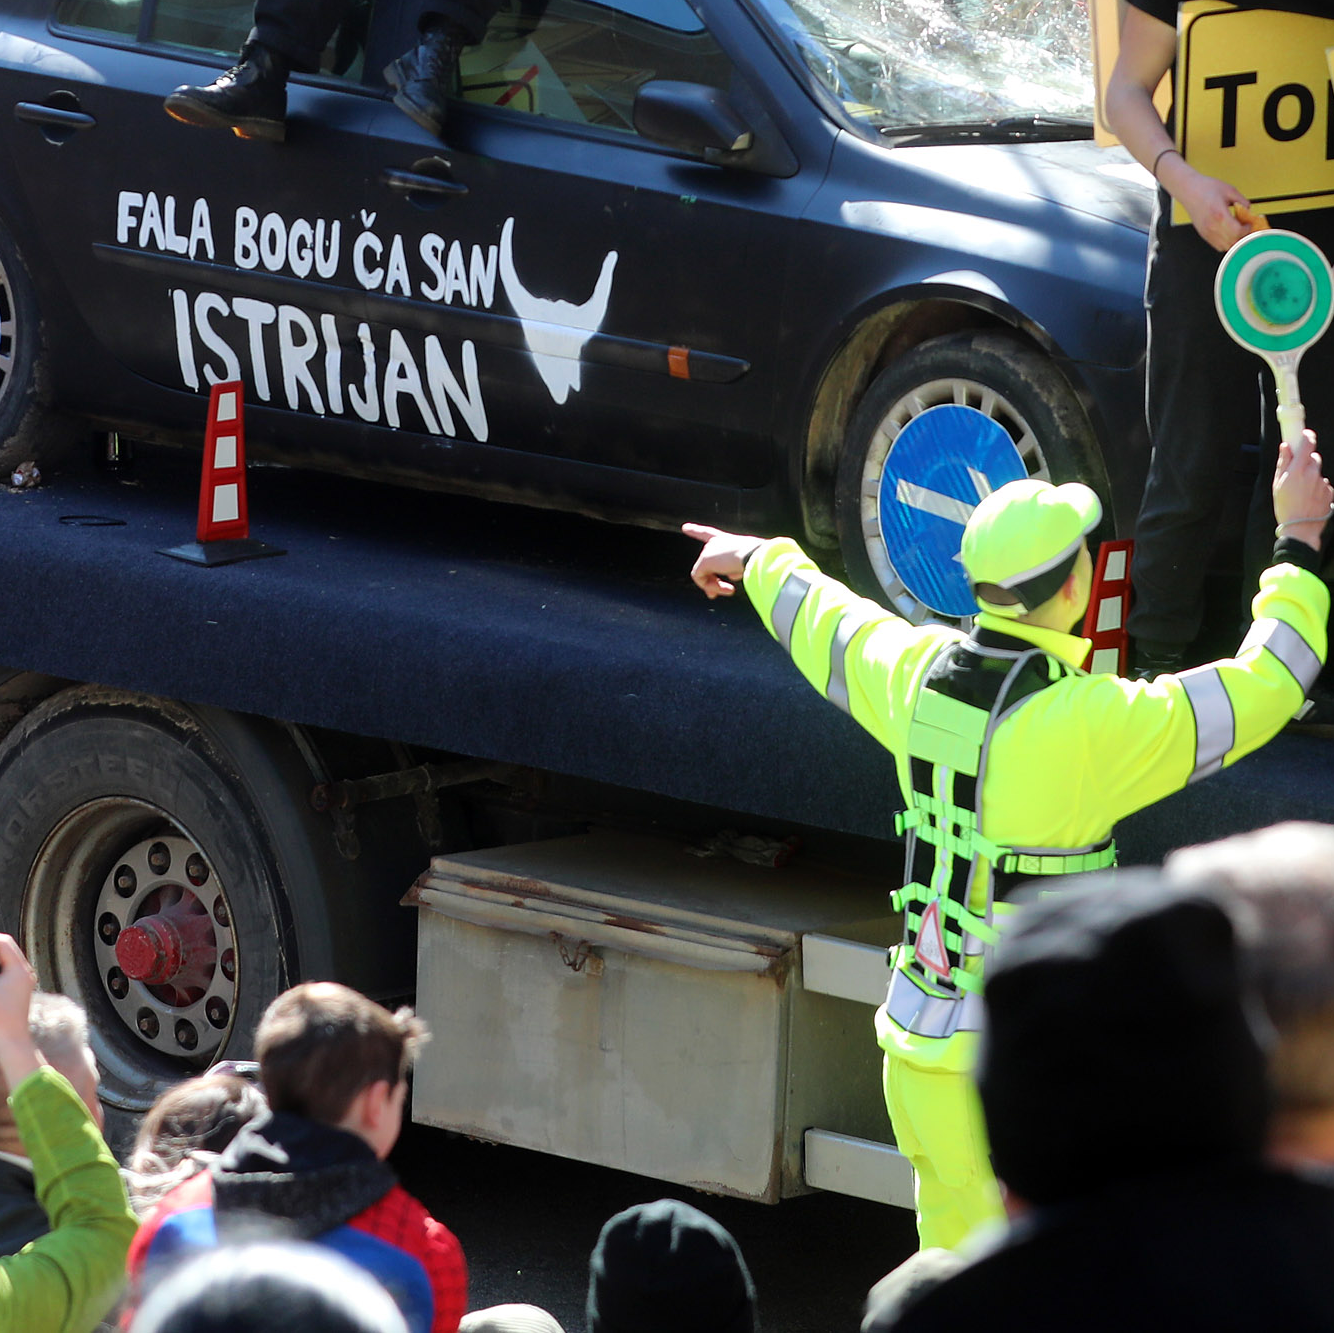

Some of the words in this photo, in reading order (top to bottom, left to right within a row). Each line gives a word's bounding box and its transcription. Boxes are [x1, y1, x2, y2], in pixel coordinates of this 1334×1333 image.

[116, 189, 216, 261] FALA
[233, 205, 342, 279] BOGU
[352, 207, 413, 298] ČA
[417, 231, 500, 310] SAN
[171, 287, 490, 444] ISTRIJAN
